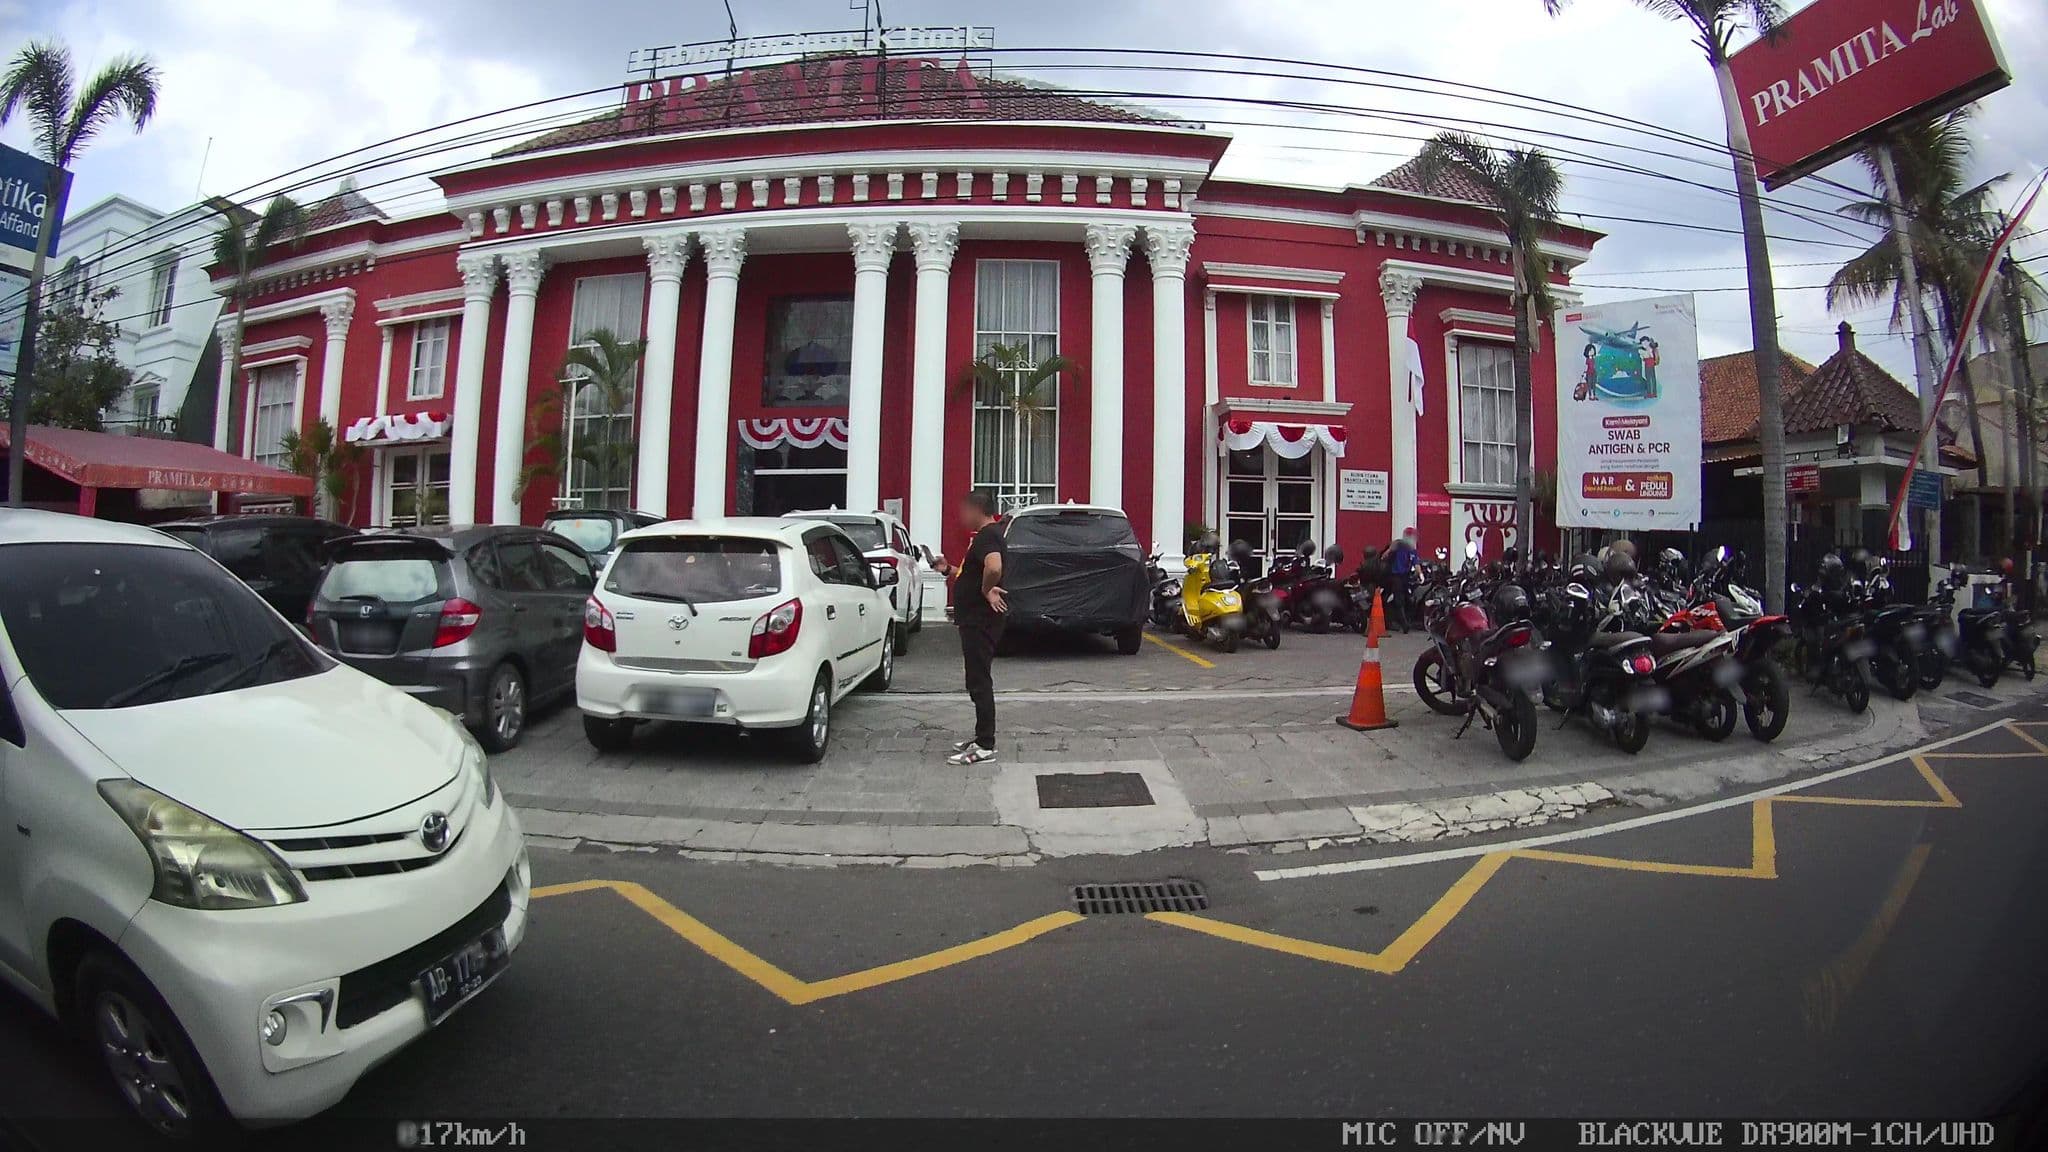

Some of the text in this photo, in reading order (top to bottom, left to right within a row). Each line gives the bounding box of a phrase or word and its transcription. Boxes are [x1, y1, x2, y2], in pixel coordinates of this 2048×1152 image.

[1751, 0, 1959, 127] PRAMITA Lab
[0, 177, 48, 219] tika
[1608, 430, 1641, 440] SWAB
[1589, 442, 1670, 455] ANTIGEN & PCR
[148, 470, 195, 487] PRAMITA
[1592, 476, 1668, 491] NAR & PEDULI
